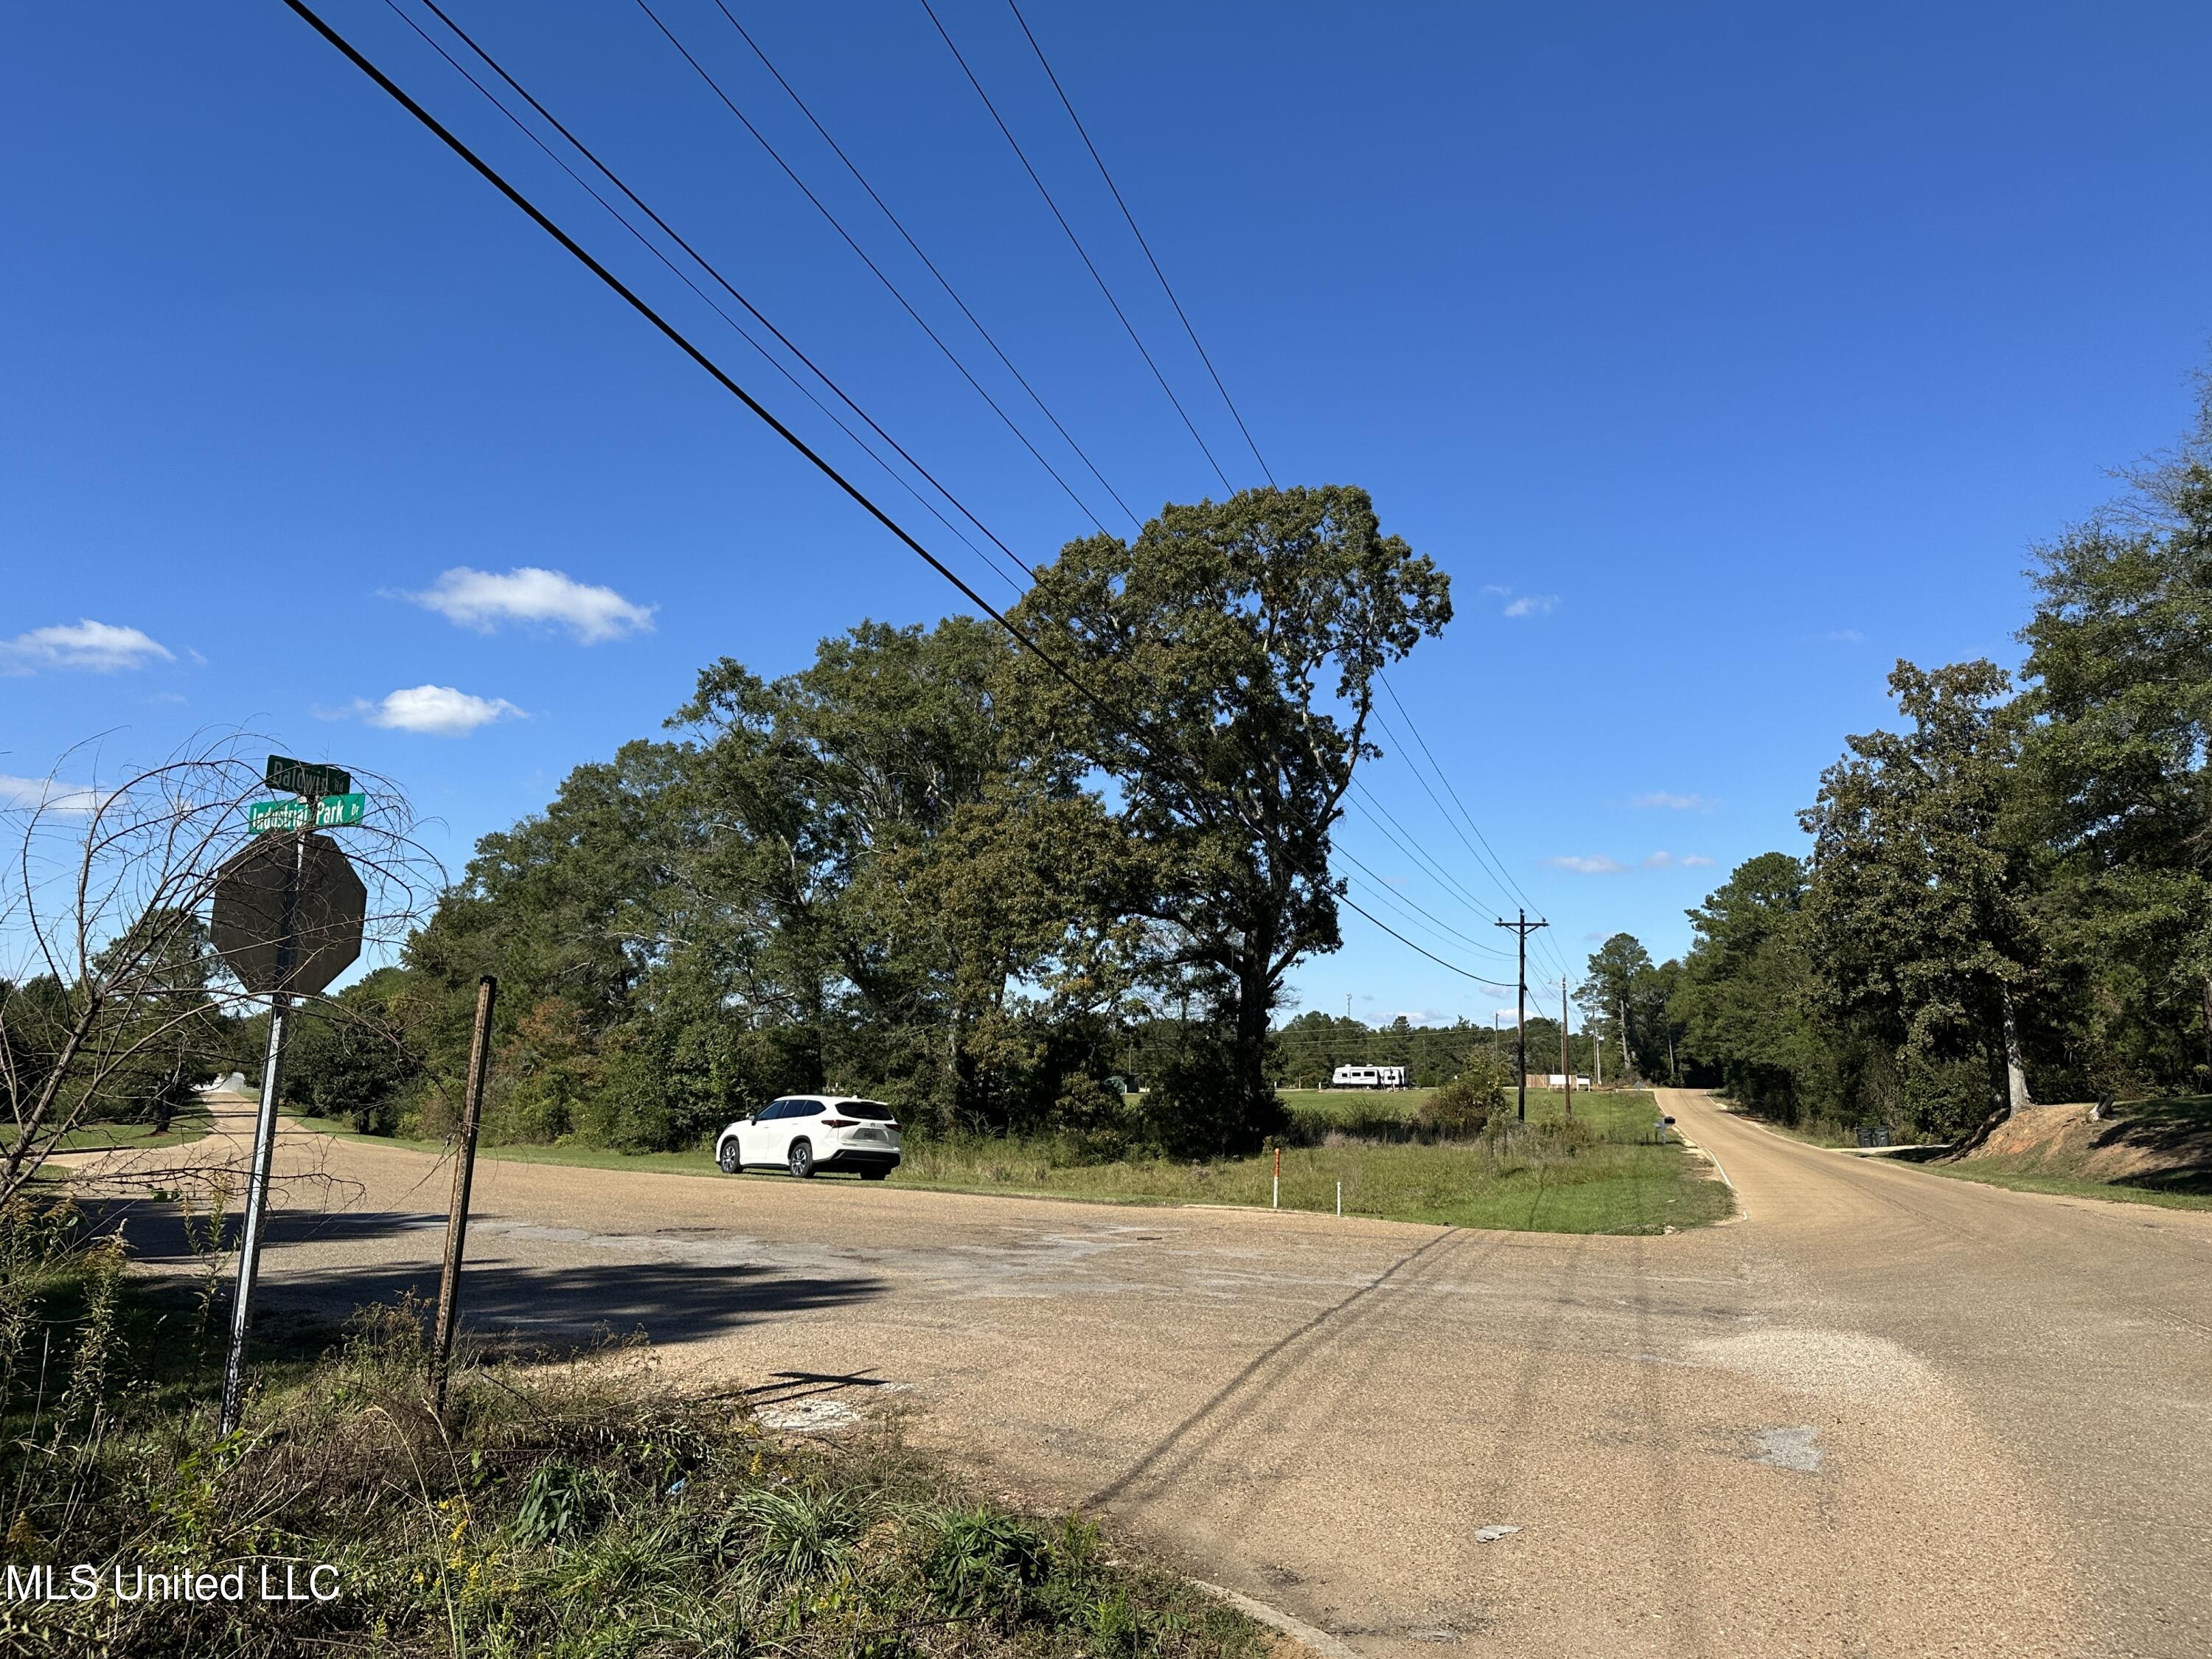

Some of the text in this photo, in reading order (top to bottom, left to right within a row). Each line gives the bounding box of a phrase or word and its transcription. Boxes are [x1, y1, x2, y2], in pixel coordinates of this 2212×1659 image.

[274, 761, 344, 793] Baldwin Rd
[252, 800, 360, 830] Industrial Park Dr
